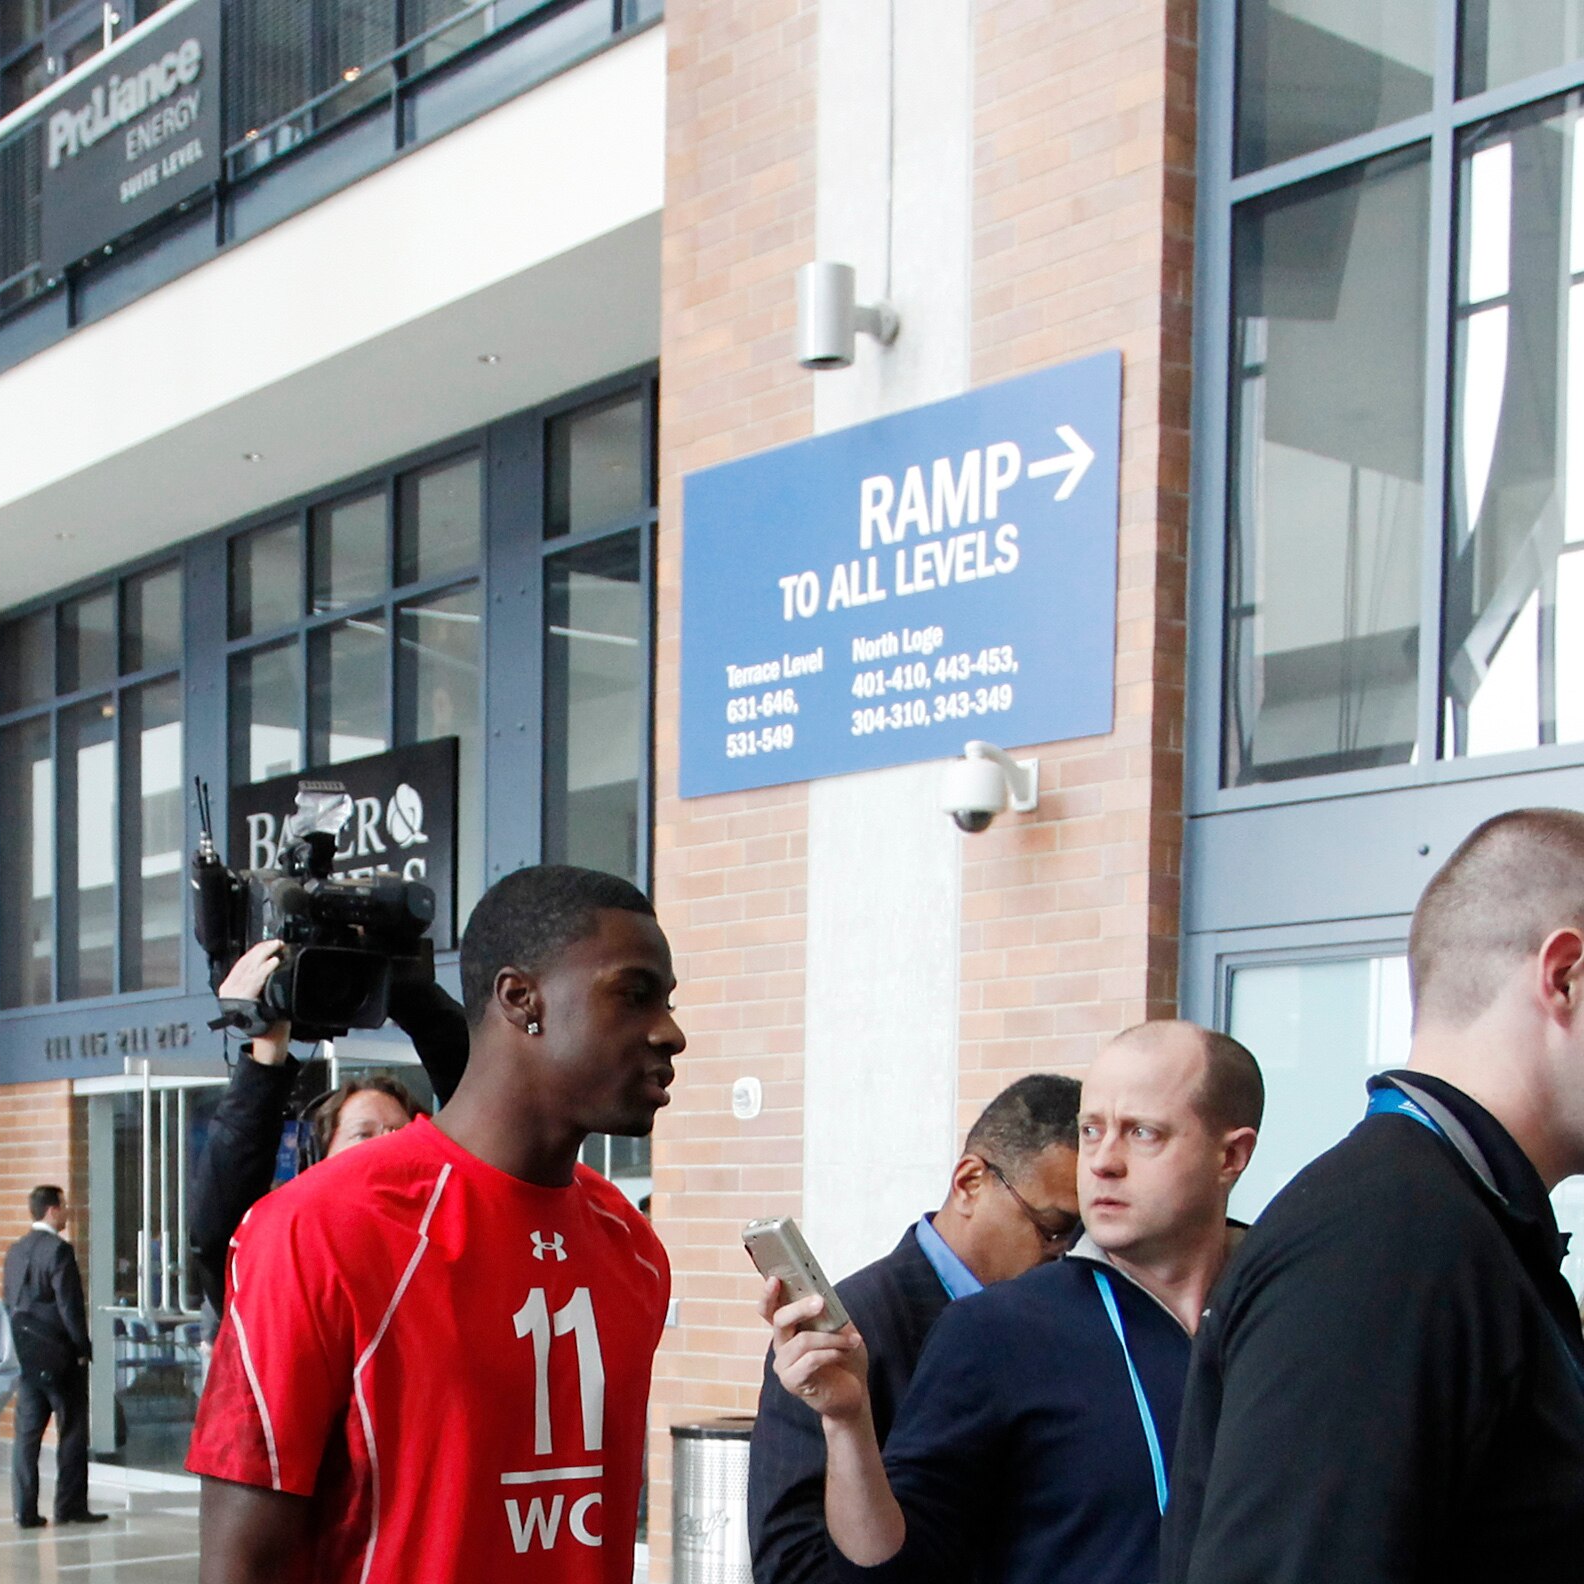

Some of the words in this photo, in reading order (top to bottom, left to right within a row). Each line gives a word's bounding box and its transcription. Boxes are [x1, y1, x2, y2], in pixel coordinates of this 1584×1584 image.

[48, 37, 203, 170] ProLiance
[125, 91, 201, 161] ENERGY
[119, 163, 160, 204] SUITE
[161, 138, 205, 178] LEVEL
[858, 441, 1022, 549] RAMP
[778, 572, 820, 622] TO
[827, 557, 888, 613] ALL
[894, 523, 1020, 597] LEVELS
[726, 658, 782, 689] Terrace
[783, 647, 823, 679] Level
[851, 630, 899, 664] North
[902, 624, 944, 656] Loge
[851, 662, 931, 700] 401-410,
[934, 645, 1020, 683] 443-453,
[726, 688, 799, 724] 631-646,
[851, 701, 931, 737] 304-310,
[933, 684, 1014, 723] 343-349
[726, 723, 794, 758] 531-549
[511, 1286, 606, 1456] 11
[504, 1492, 604, 1554] WC
